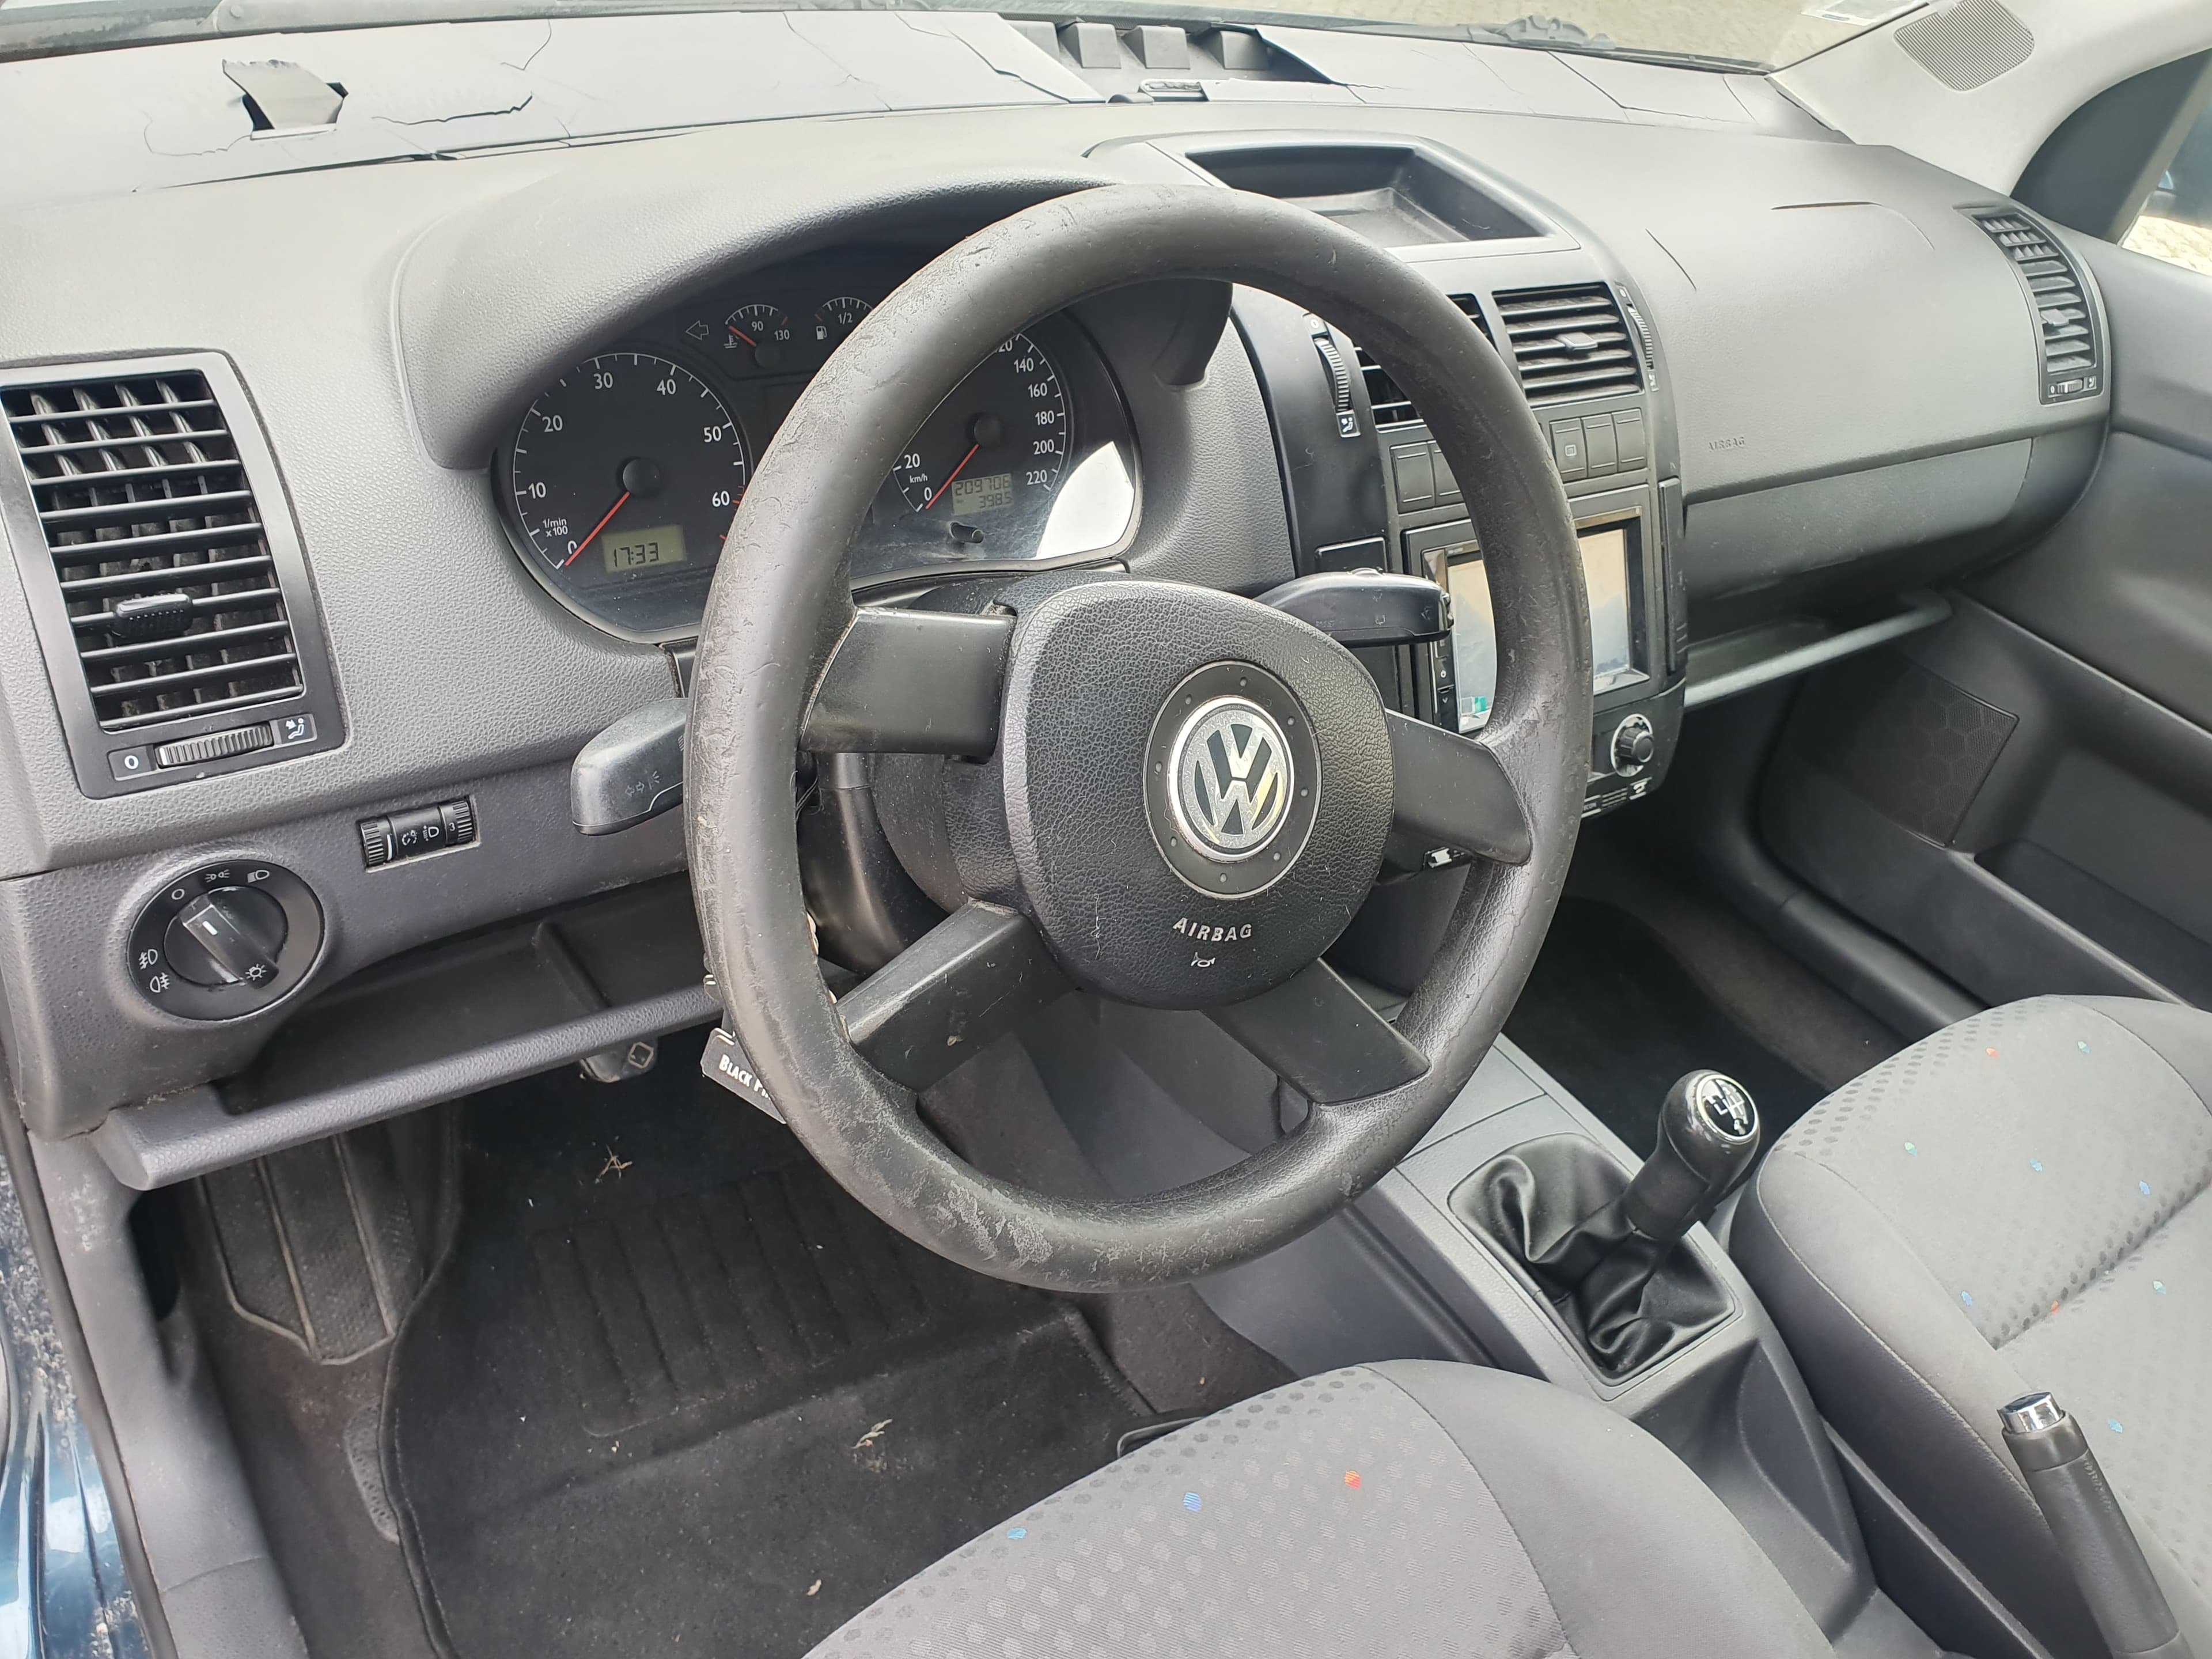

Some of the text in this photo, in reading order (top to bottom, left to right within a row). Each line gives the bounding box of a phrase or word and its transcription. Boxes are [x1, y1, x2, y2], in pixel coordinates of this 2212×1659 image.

[751, 321, 764, 332] 90
[838, 312, 853, 325] 1/2
[774, 329, 790, 341] 130
[1013, 357, 1034, 374] 140
[593, 372, 613, 390] 30
[656, 378, 676, 396] 40
[1027, 382, 1048, 399] 160
[542, 414, 563, 433] 20
[1035, 410, 1055, 426] 180
[703, 426, 722, 443] 50
[1032, 439, 1055, 455] 200
[903, 453, 921, 469] 20
[909, 473, 929, 484] km/h
[1025, 469, 1048, 486] 220
[528, 481, 547, 499] 10
[711, 490, 730, 507] 60
[923, 486, 933, 501] 0
[542, 517, 567, 528] 1/min
[613, 541, 660, 567] 17:33
[1172, 916, 1253, 942] AIRBAG
[718, 1054, 753, 1088] BLACK
